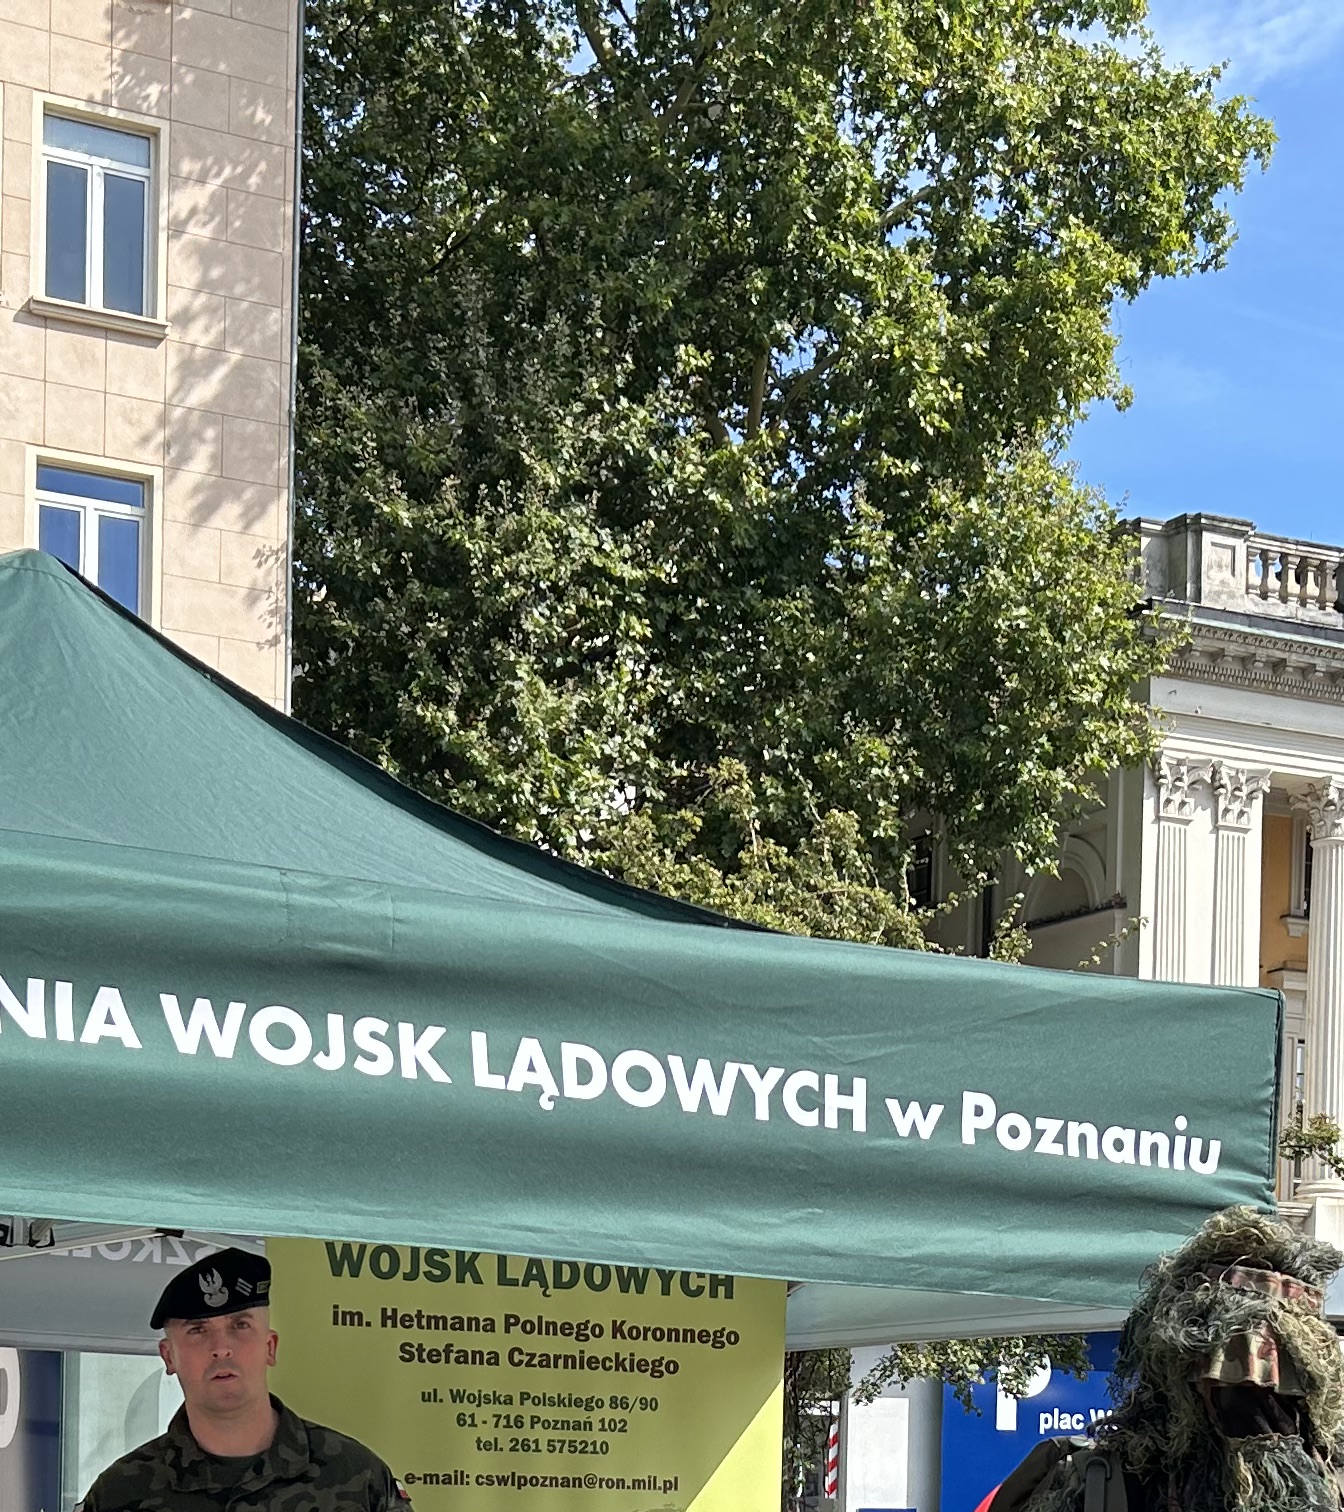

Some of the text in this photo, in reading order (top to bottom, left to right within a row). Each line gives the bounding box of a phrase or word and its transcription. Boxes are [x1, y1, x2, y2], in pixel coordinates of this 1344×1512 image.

[158, 992, 454, 1085] WOJSK
[469, 1029, 868, 1134] LĄDOWYCH
[883, 1096, 946, 1141] w
[960, 1089, 1223, 1179] Poznaniu
[324, 1241, 735, 1300] WOJSK LĄDOWYCH
[332, 1303, 740, 1350] im. Hetmana Polnego Koronnego
[398, 1341, 680, 1379] Stefana Czarnieckiego
[420, 1388, 660, 1414] ul. Wojska Polskiego 86/90
[456, 1412, 478, 1428] 61
[492, 1413, 525, 1430] 716
[529, 1414, 593, 1433] Poznań
[598, 1417, 628, 1433] 102
[1039, 1407, 1085, 1435] plac
[475, 1436, 610, 1456] tel. 261 575210
[404, 1469, 679, 1495] e-mail: cswlpoznan@ron.mil.pl
